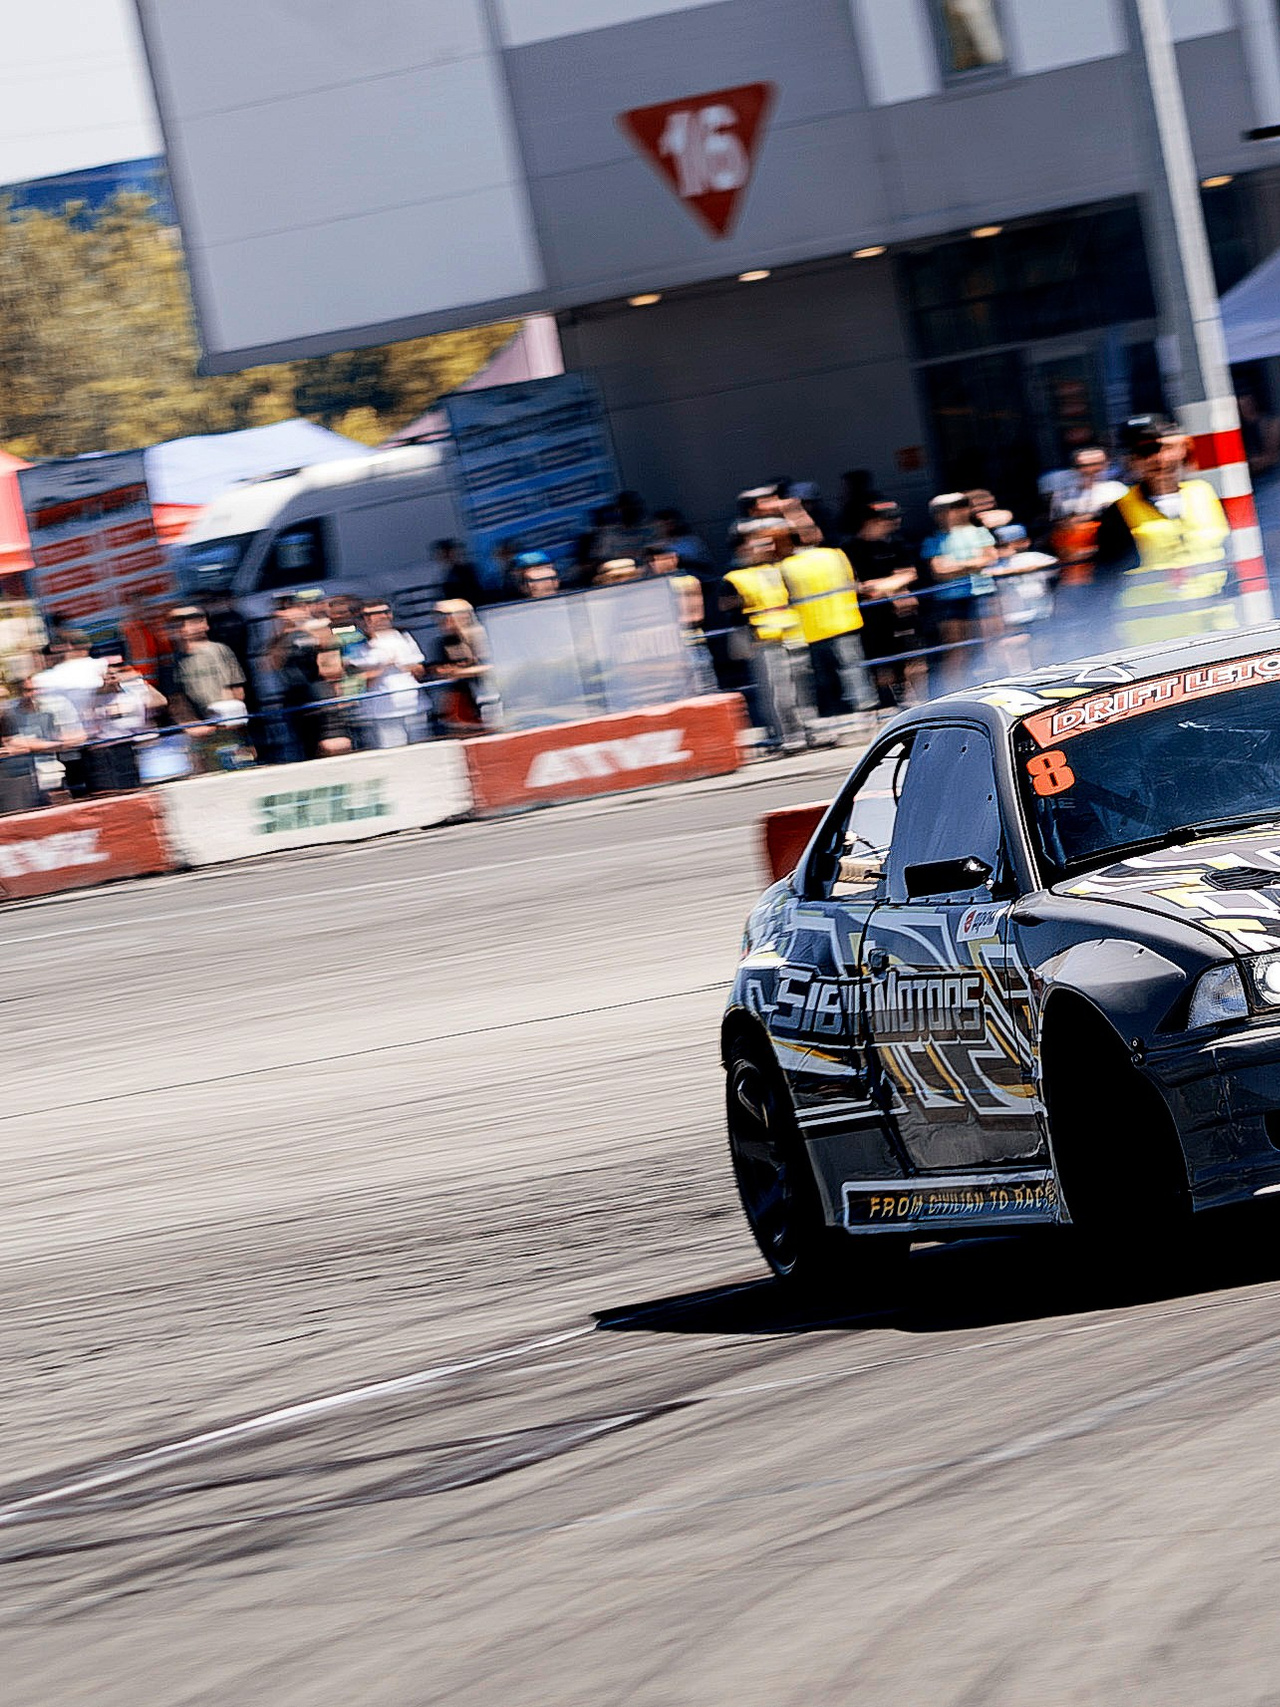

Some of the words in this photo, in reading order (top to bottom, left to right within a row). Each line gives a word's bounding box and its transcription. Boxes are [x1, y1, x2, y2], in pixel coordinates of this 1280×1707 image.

[658, 103, 750, 198] 16
[1052, 675, 1179, 736] DRIFT
[1026, 750, 1075, 796] 8
[869, 1195, 923, 1219] FROM
[990, 1187, 1009, 1211] TO
